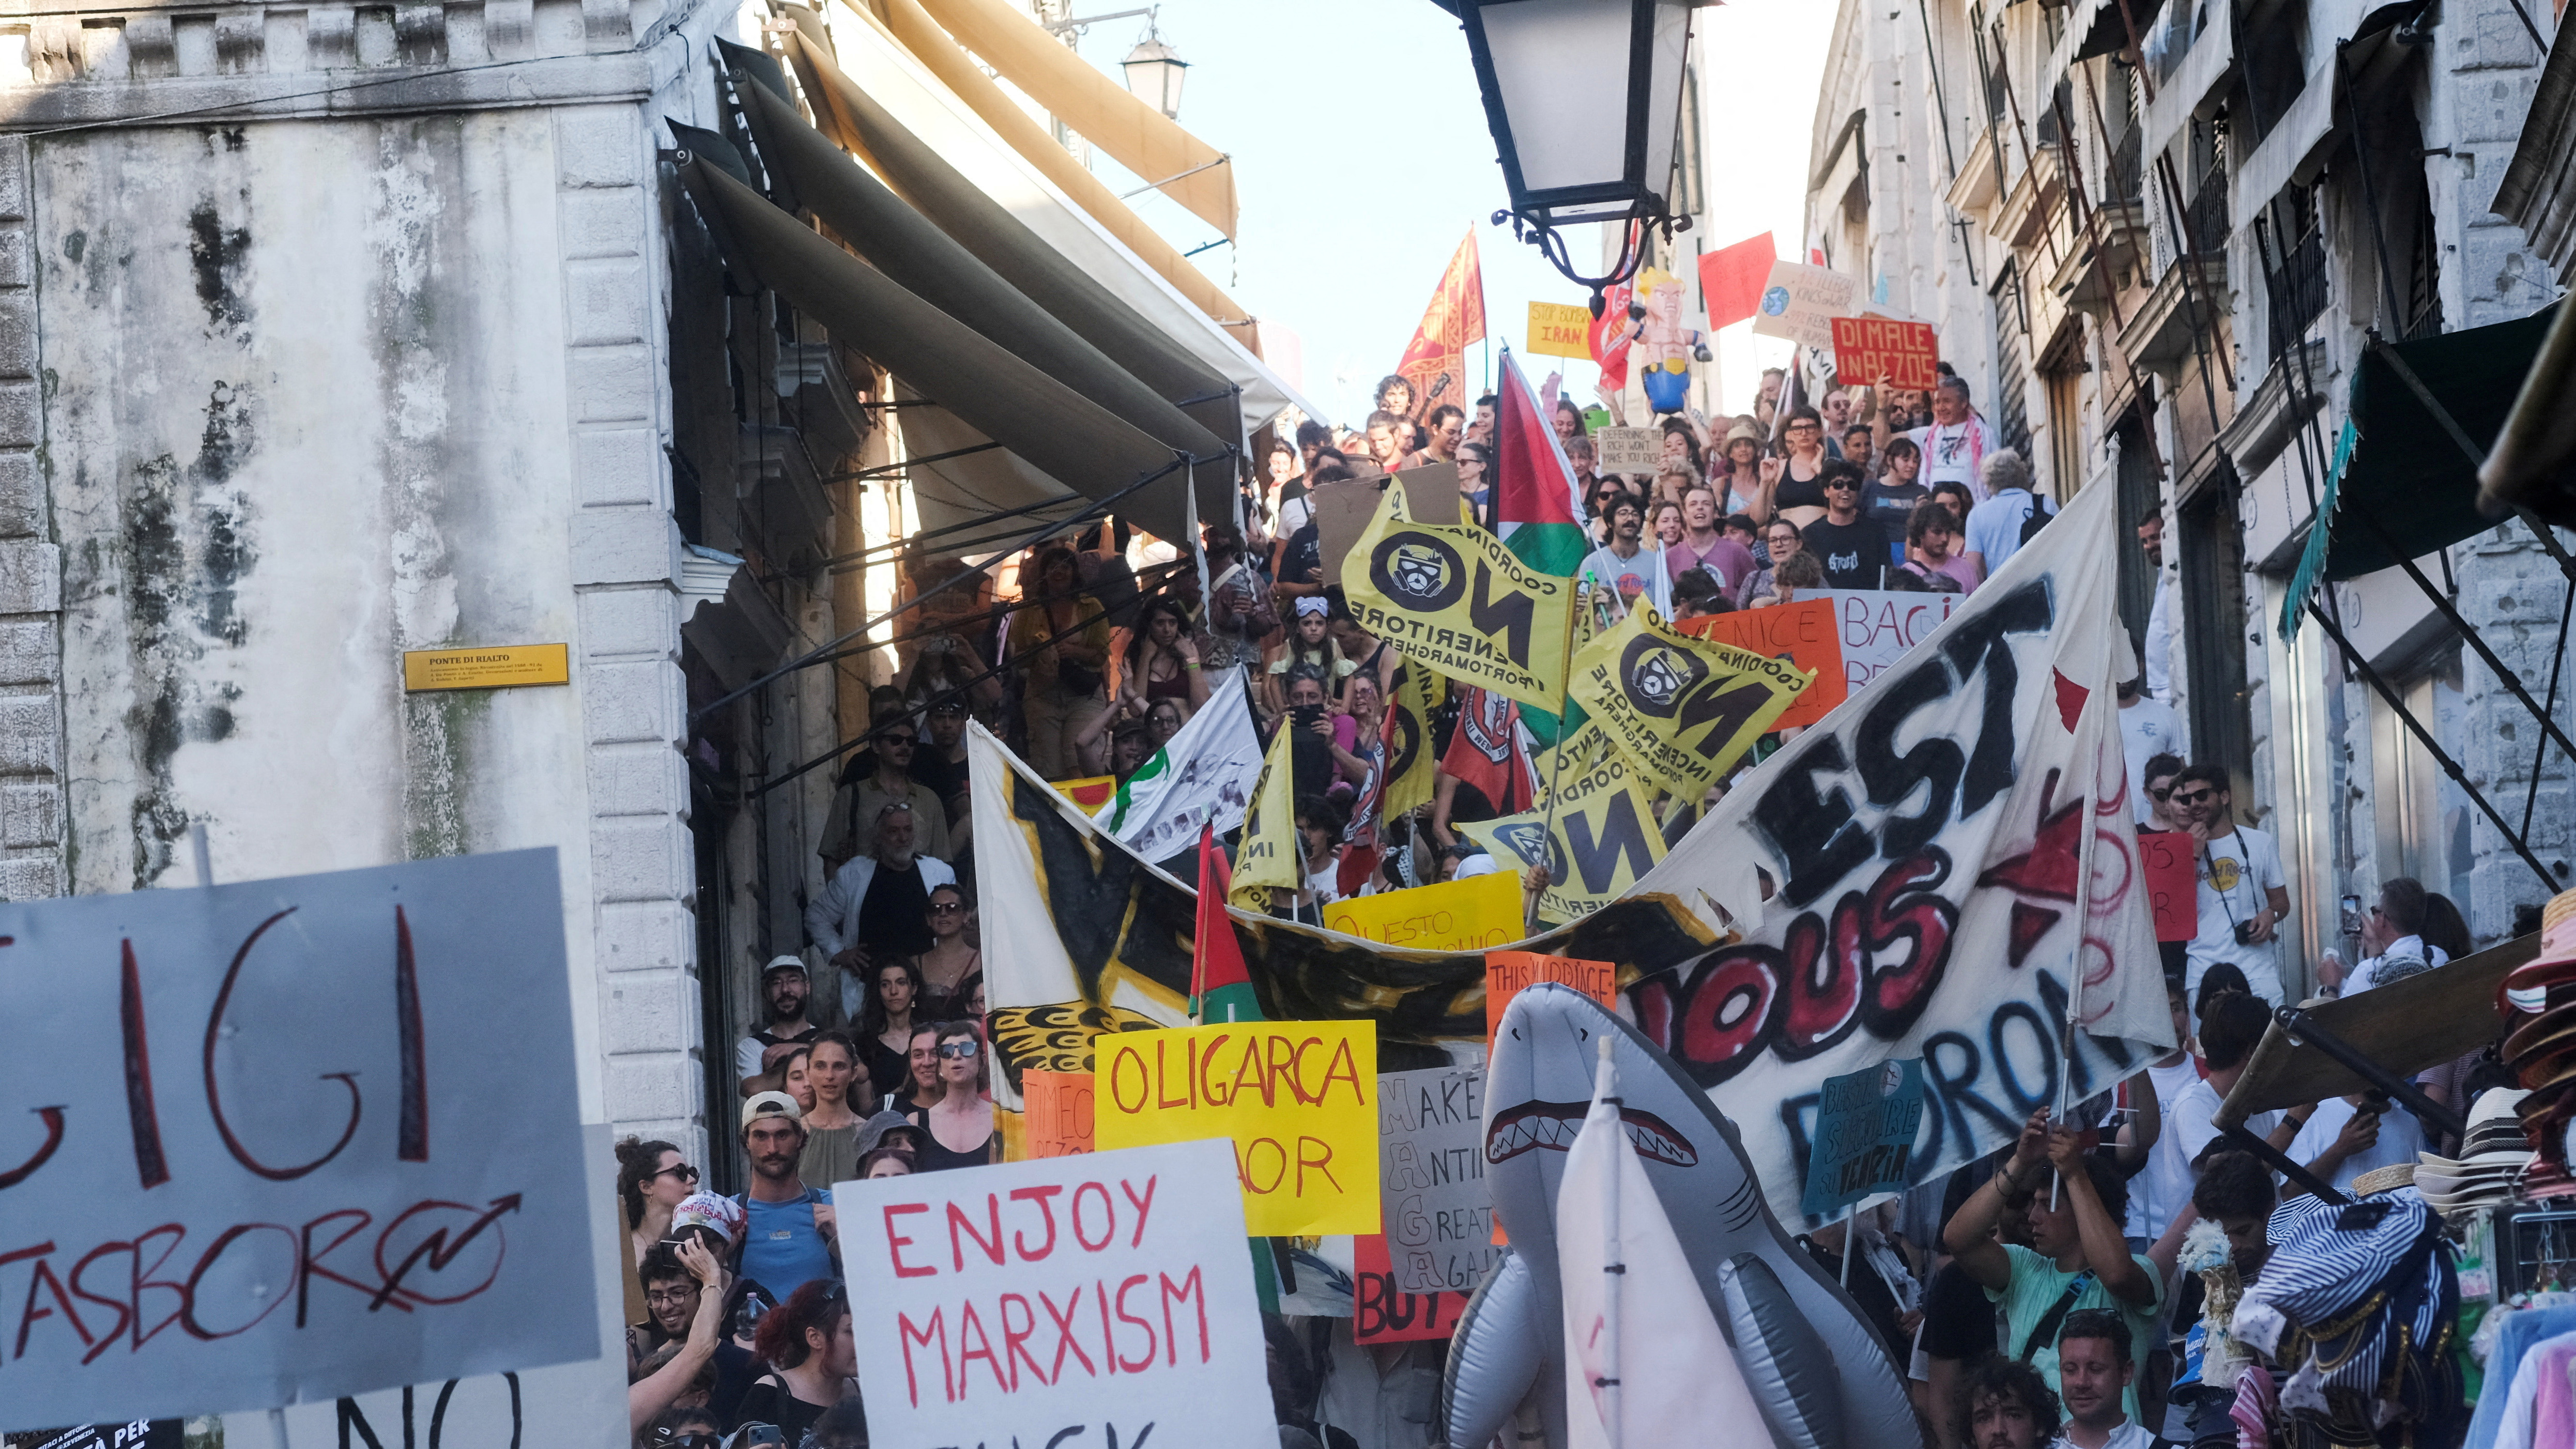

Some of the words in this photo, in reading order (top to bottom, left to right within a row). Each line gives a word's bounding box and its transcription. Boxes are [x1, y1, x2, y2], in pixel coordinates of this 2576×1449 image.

[1541, 326, 1582, 345] IRAN
[1839, 320, 1862, 348] DI
[1866, 321, 1929, 352] MALE
[1863, 350, 1937, 388] BEZOS
[1603, 429, 1646, 440] DEFENDING
[1607, 441, 1624, 451] RICH
[1603, 452, 1622, 463] MAKE
[1627, 453, 1640, 462] YOU
[1643, 453, 1660, 464] RICH
[1490, 964, 1529, 991] THIS
[1111, 1034, 1364, 1115] OLIGARCA
[1025, 1082, 1095, 1139] TIMEO
[1377, 1076, 1480, 1136] MAKE
[883, 1174, 1157, 1278] ENJOY
[1397, 1194, 1493, 1247] GREAT
[897, 1264, 1211, 1409] MARXISM
[115, 1418, 150, 1449] PER
